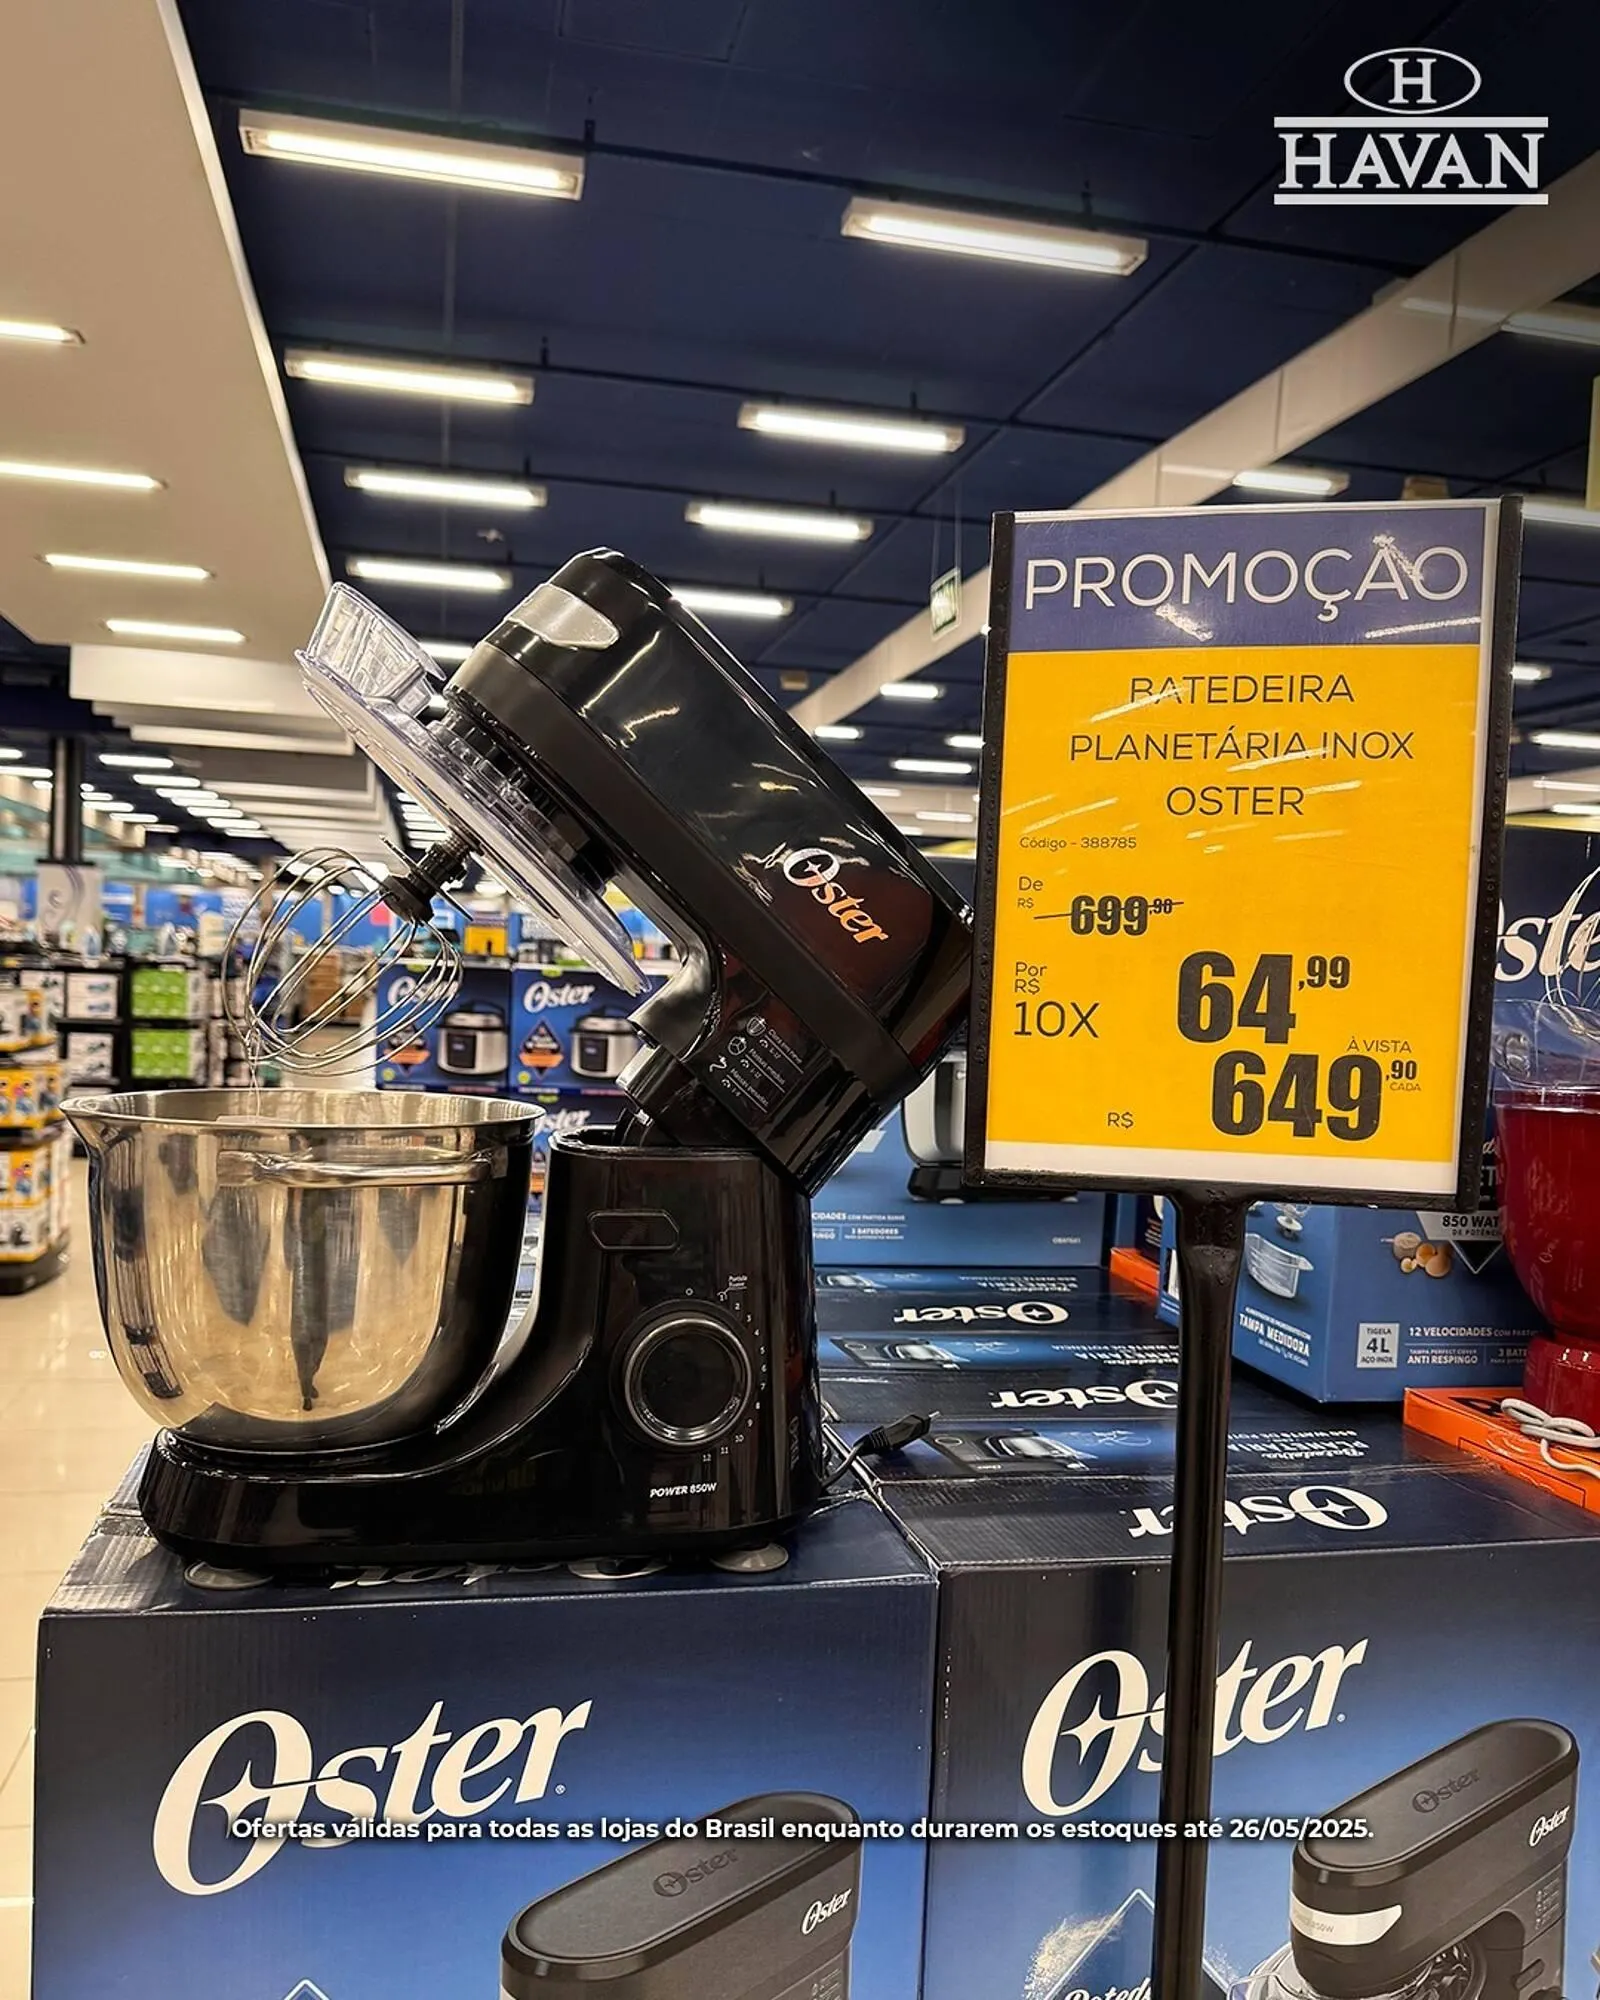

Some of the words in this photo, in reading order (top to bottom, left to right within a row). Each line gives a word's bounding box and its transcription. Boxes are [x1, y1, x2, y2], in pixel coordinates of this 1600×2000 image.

[1024, 536, 1468, 621] PROMOÇÃO
[1130, 674, 1355, 704] BATEDEIRA
[1071, 726, 1308, 761] PLANETÁRIA
[1321, 732, 1414, 760] INOX
[1166, 786, 1305, 816] OSTER
[1019, 836, 1067, 851] Código
[1080, 837, 1137, 848] 388785
[783, 847, 889, 943] Oster
[1018, 876, 1043, 891] De
[1017, 897, 1034, 908] R$
[1494, 890, 1600, 982] ste
[1015, 961, 1047, 976] Por
[523, 980, 596, 1014] Oster
[1014, 978, 1040, 995] R$
[1014, 1001, 1100, 1038] 10X
[1364, 1039, 1412, 1054] VISTA
[1390, 1082, 1421, 1092] CADA
[1107, 1112, 1134, 1129] R$
[1442, 1215, 1468, 1227] 850
[1471, 1215, 1499, 1228] WAT
[894, 1301, 1069, 1324] Oster
[1239, 1313, 1265, 1336] TAMPA
[1267, 1325, 1310, 1357] MEDIDORA
[1366, 1327, 1392, 1336] TIGELA
[1409, 1327, 1421, 1337] 12
[1423, 1326, 1492, 1337] VELOCIDADES
[1407, 1355, 1430, 1364] ANTI
[1431, 1355, 1478, 1364] RESPINGO
[991, 1379, 1179, 1410] Oster
[735, 1434, 745, 1443] 10
[702, 1453, 712, 1462] 12
[720, 1446, 729, 1455] 11
[650, 1485, 688, 1498] POWER
[690, 1482, 717, 1494] 850W
[1128, 1485, 1388, 1538] Ostr
[152, 1699, 593, 1896] Oster
[1412, 1769, 1481, 1813] Oster
[1529, 1805, 1571, 1847] Oster
[653, 1848, 739, 1897] Oster
[801, 1887, 852, 1935] Oster
